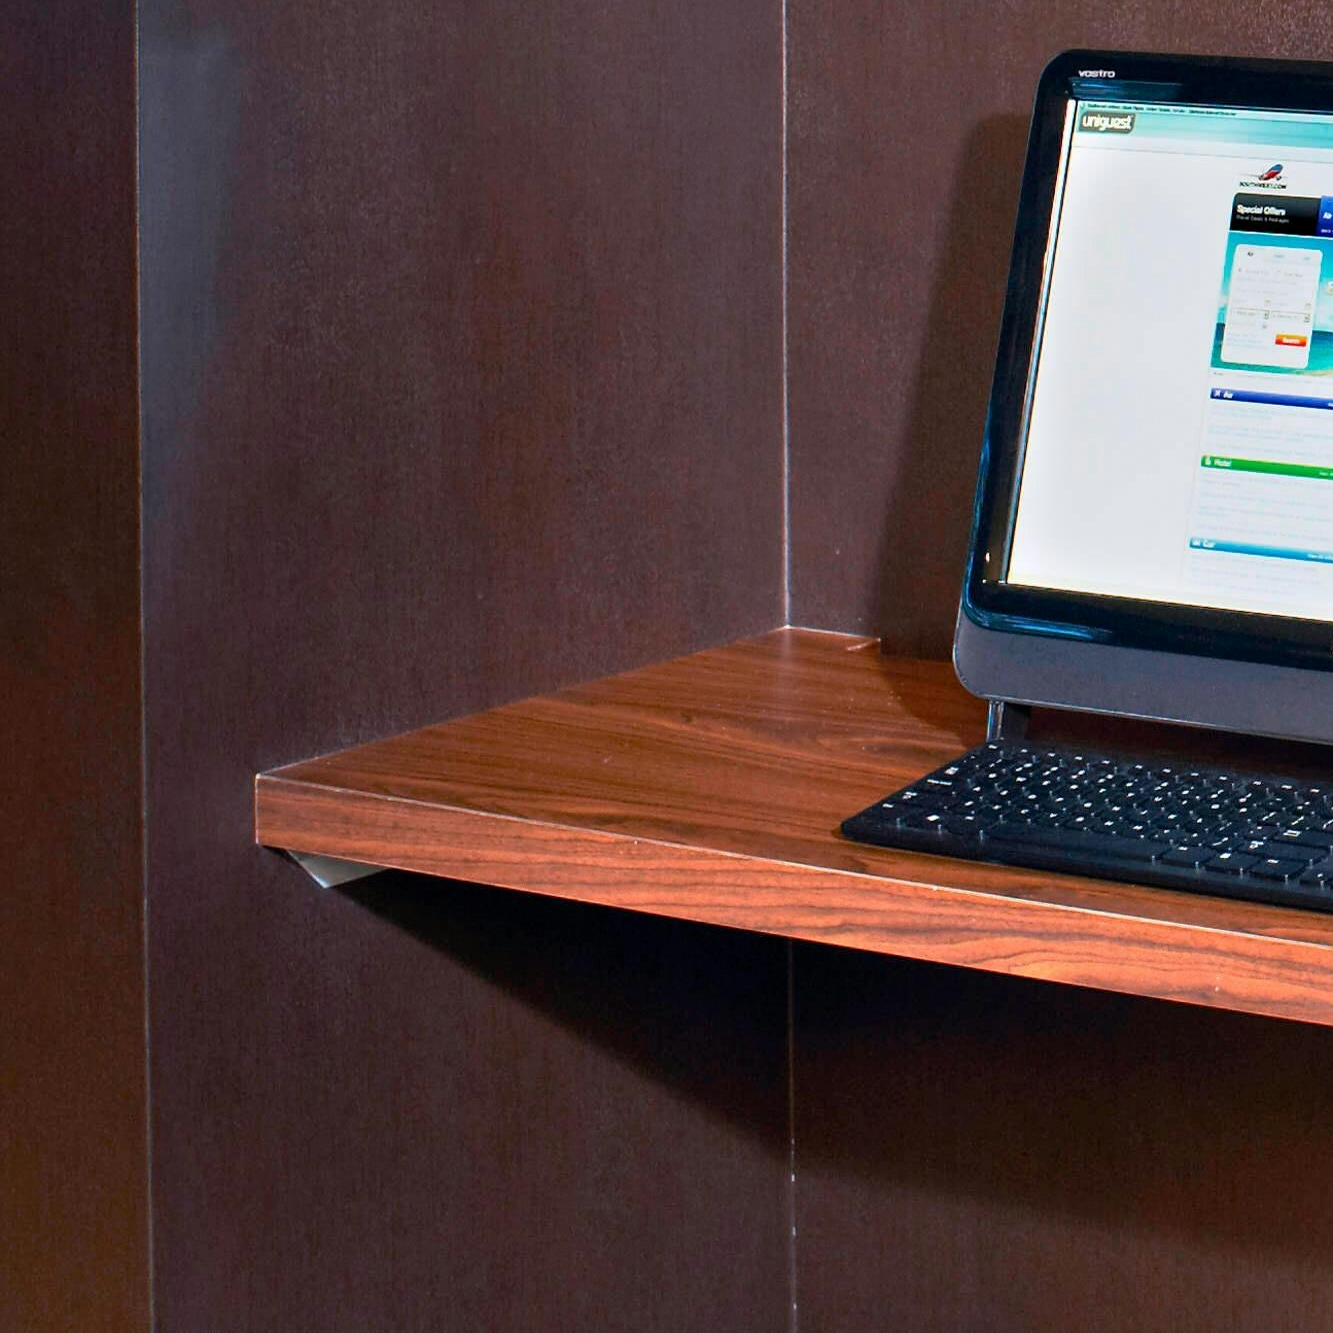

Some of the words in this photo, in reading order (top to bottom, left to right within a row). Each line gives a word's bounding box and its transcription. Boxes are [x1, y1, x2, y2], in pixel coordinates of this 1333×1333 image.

[1078, 69, 1116, 78] vostro
[1082, 114, 1133, 131] uniguest
[1236, 204, 1263, 215] Special
[1264, 206, 1286, 216] Offers
